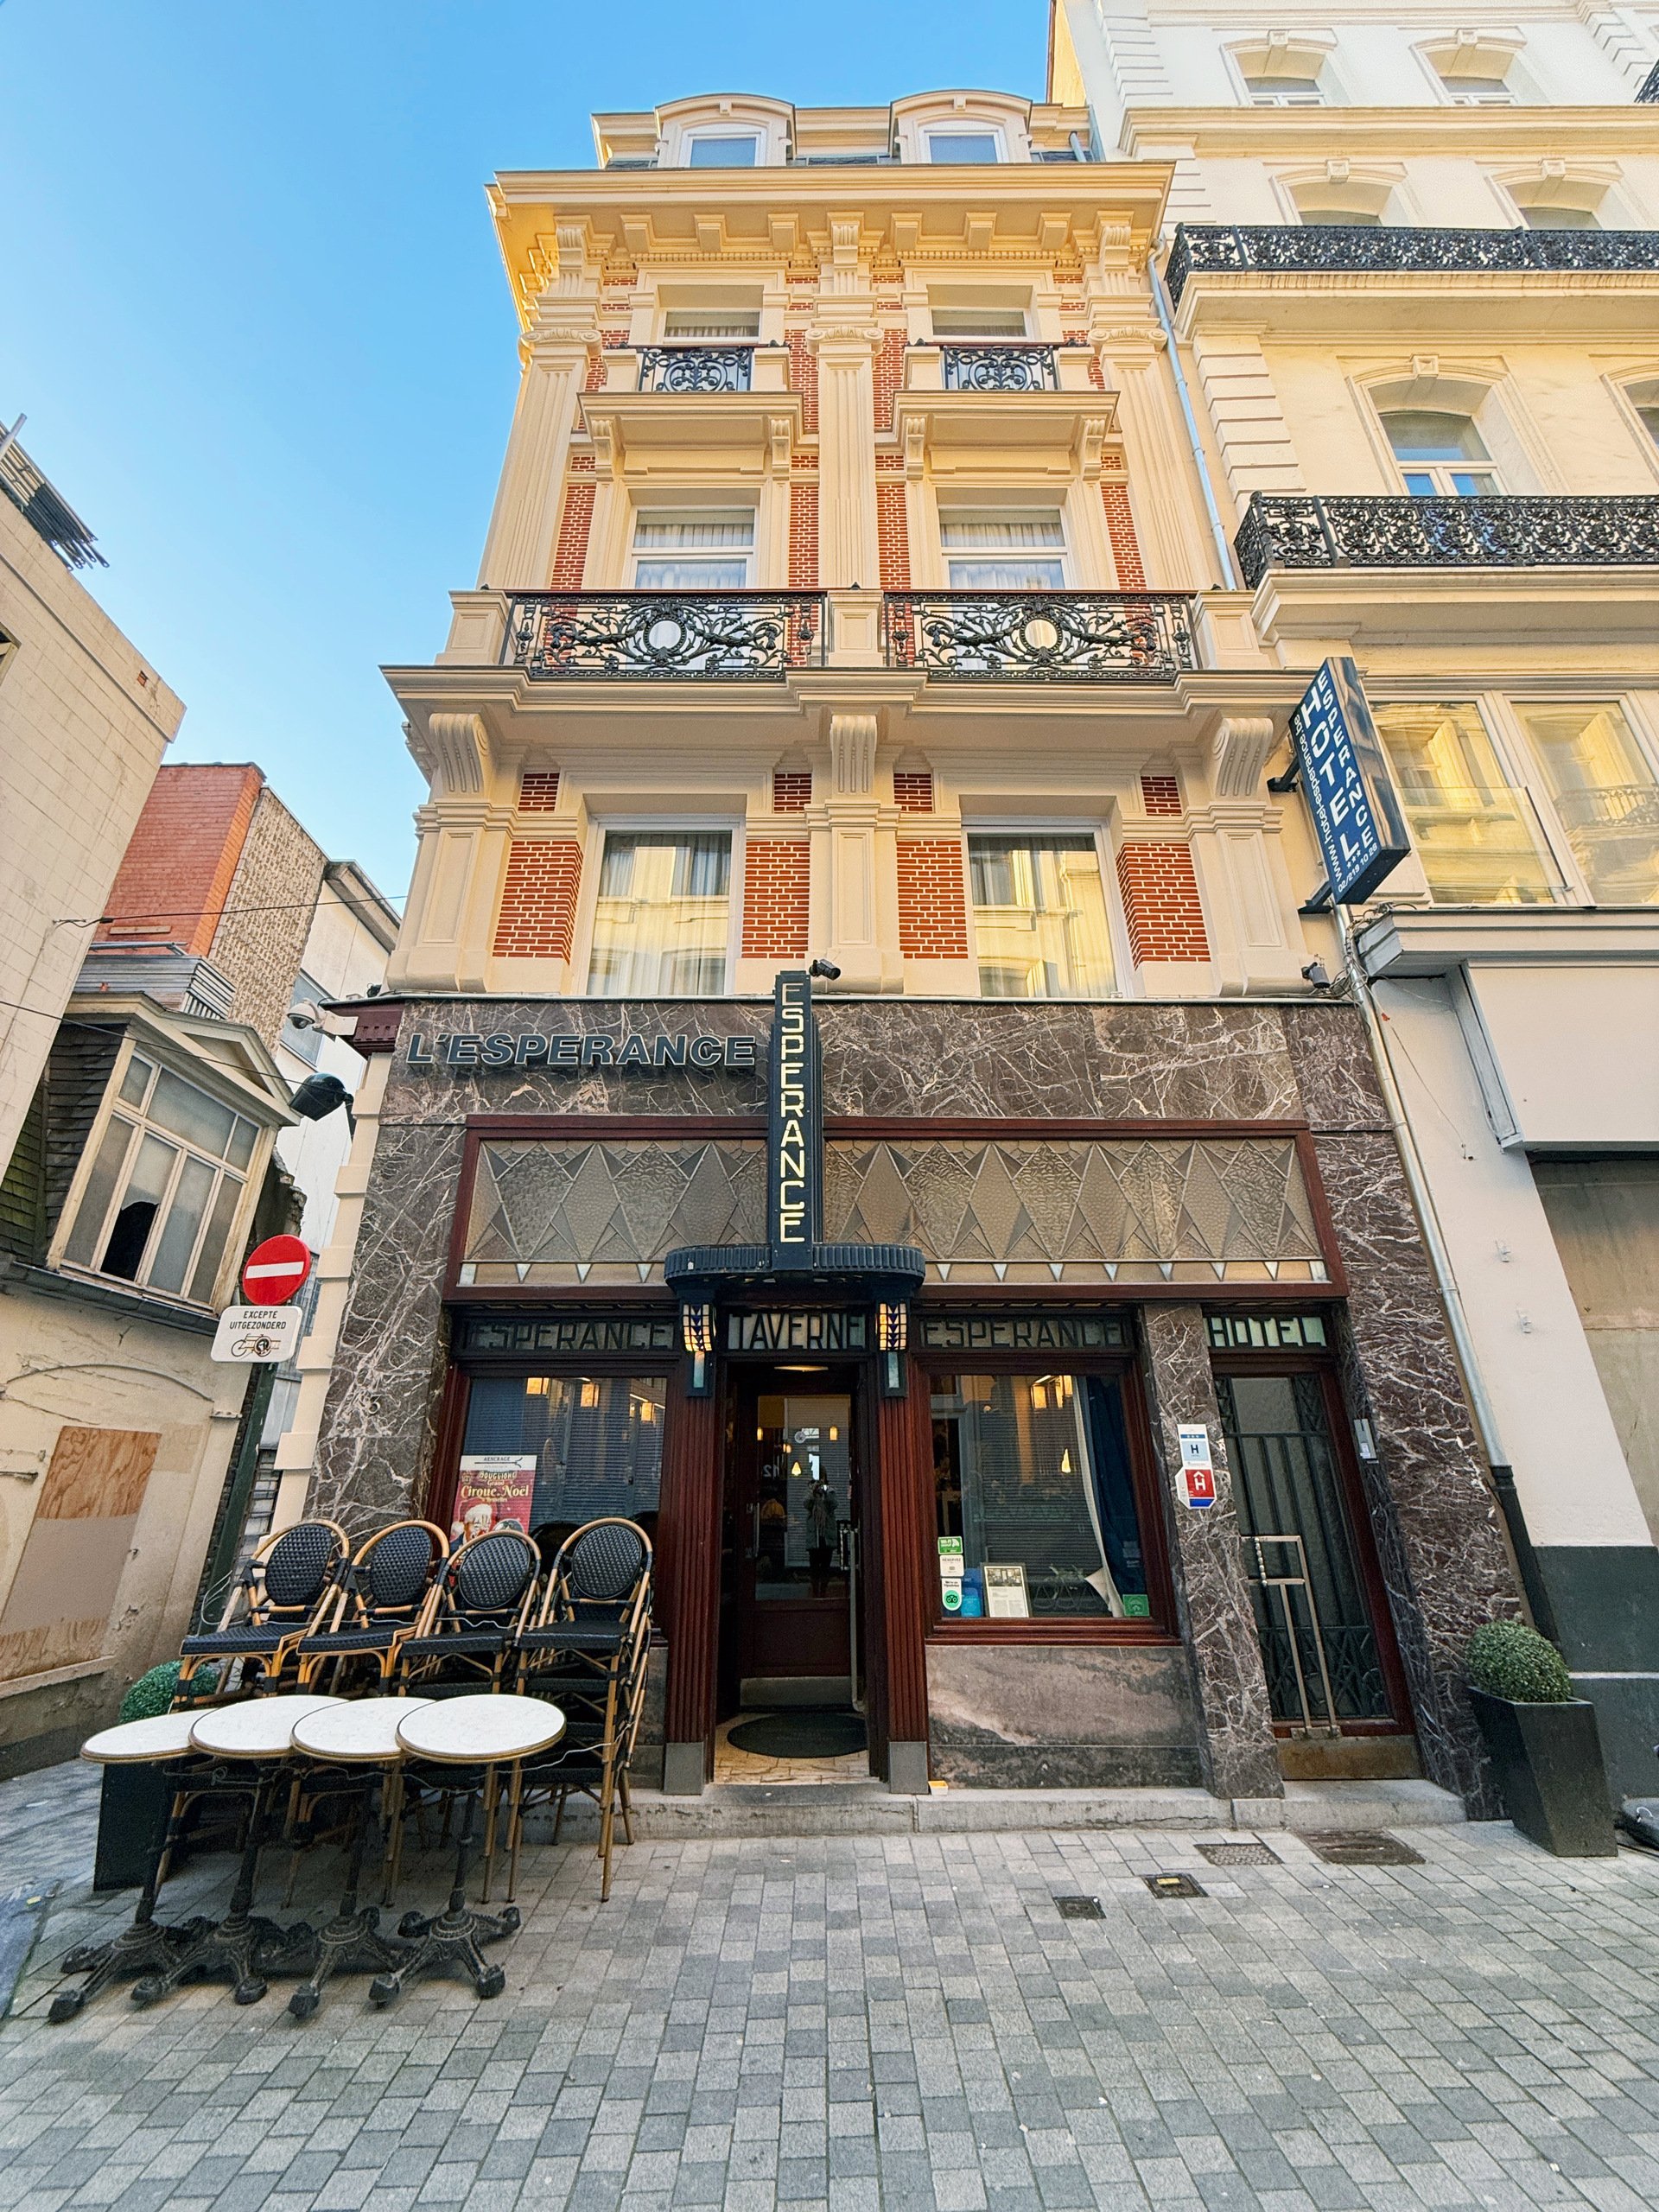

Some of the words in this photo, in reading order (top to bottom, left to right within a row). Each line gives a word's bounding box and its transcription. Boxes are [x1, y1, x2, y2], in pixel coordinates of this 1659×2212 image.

[1300, 686, 1359, 862] HOTEL
[1317, 671, 1374, 849] ESPERANCE
[1294, 714, 1343, 882] www.hotel-esperance.be
[1338, 864, 1360, 893] 02/219
[405, 1033, 756, 1067] L'ESPERANCE
[779, 982, 805, 1243] ESPERANCE
[229, 1321, 287, 1330] UITGEZONDERD
[243, 1310, 278, 1319] EXCEPTE
[471, 1320, 668, 1350] ESPERANCE
[731, 1313, 865, 1350] TAVERNE
[923, 1319, 1123, 1348] ESPERANCE
[1205, 1316, 1324, 1347] HOTEL
[1190, 1444, 1199, 1454] H
[461, 1485, 497, 1500] Cirque
[501, 1484, 530, 1498] Noël
